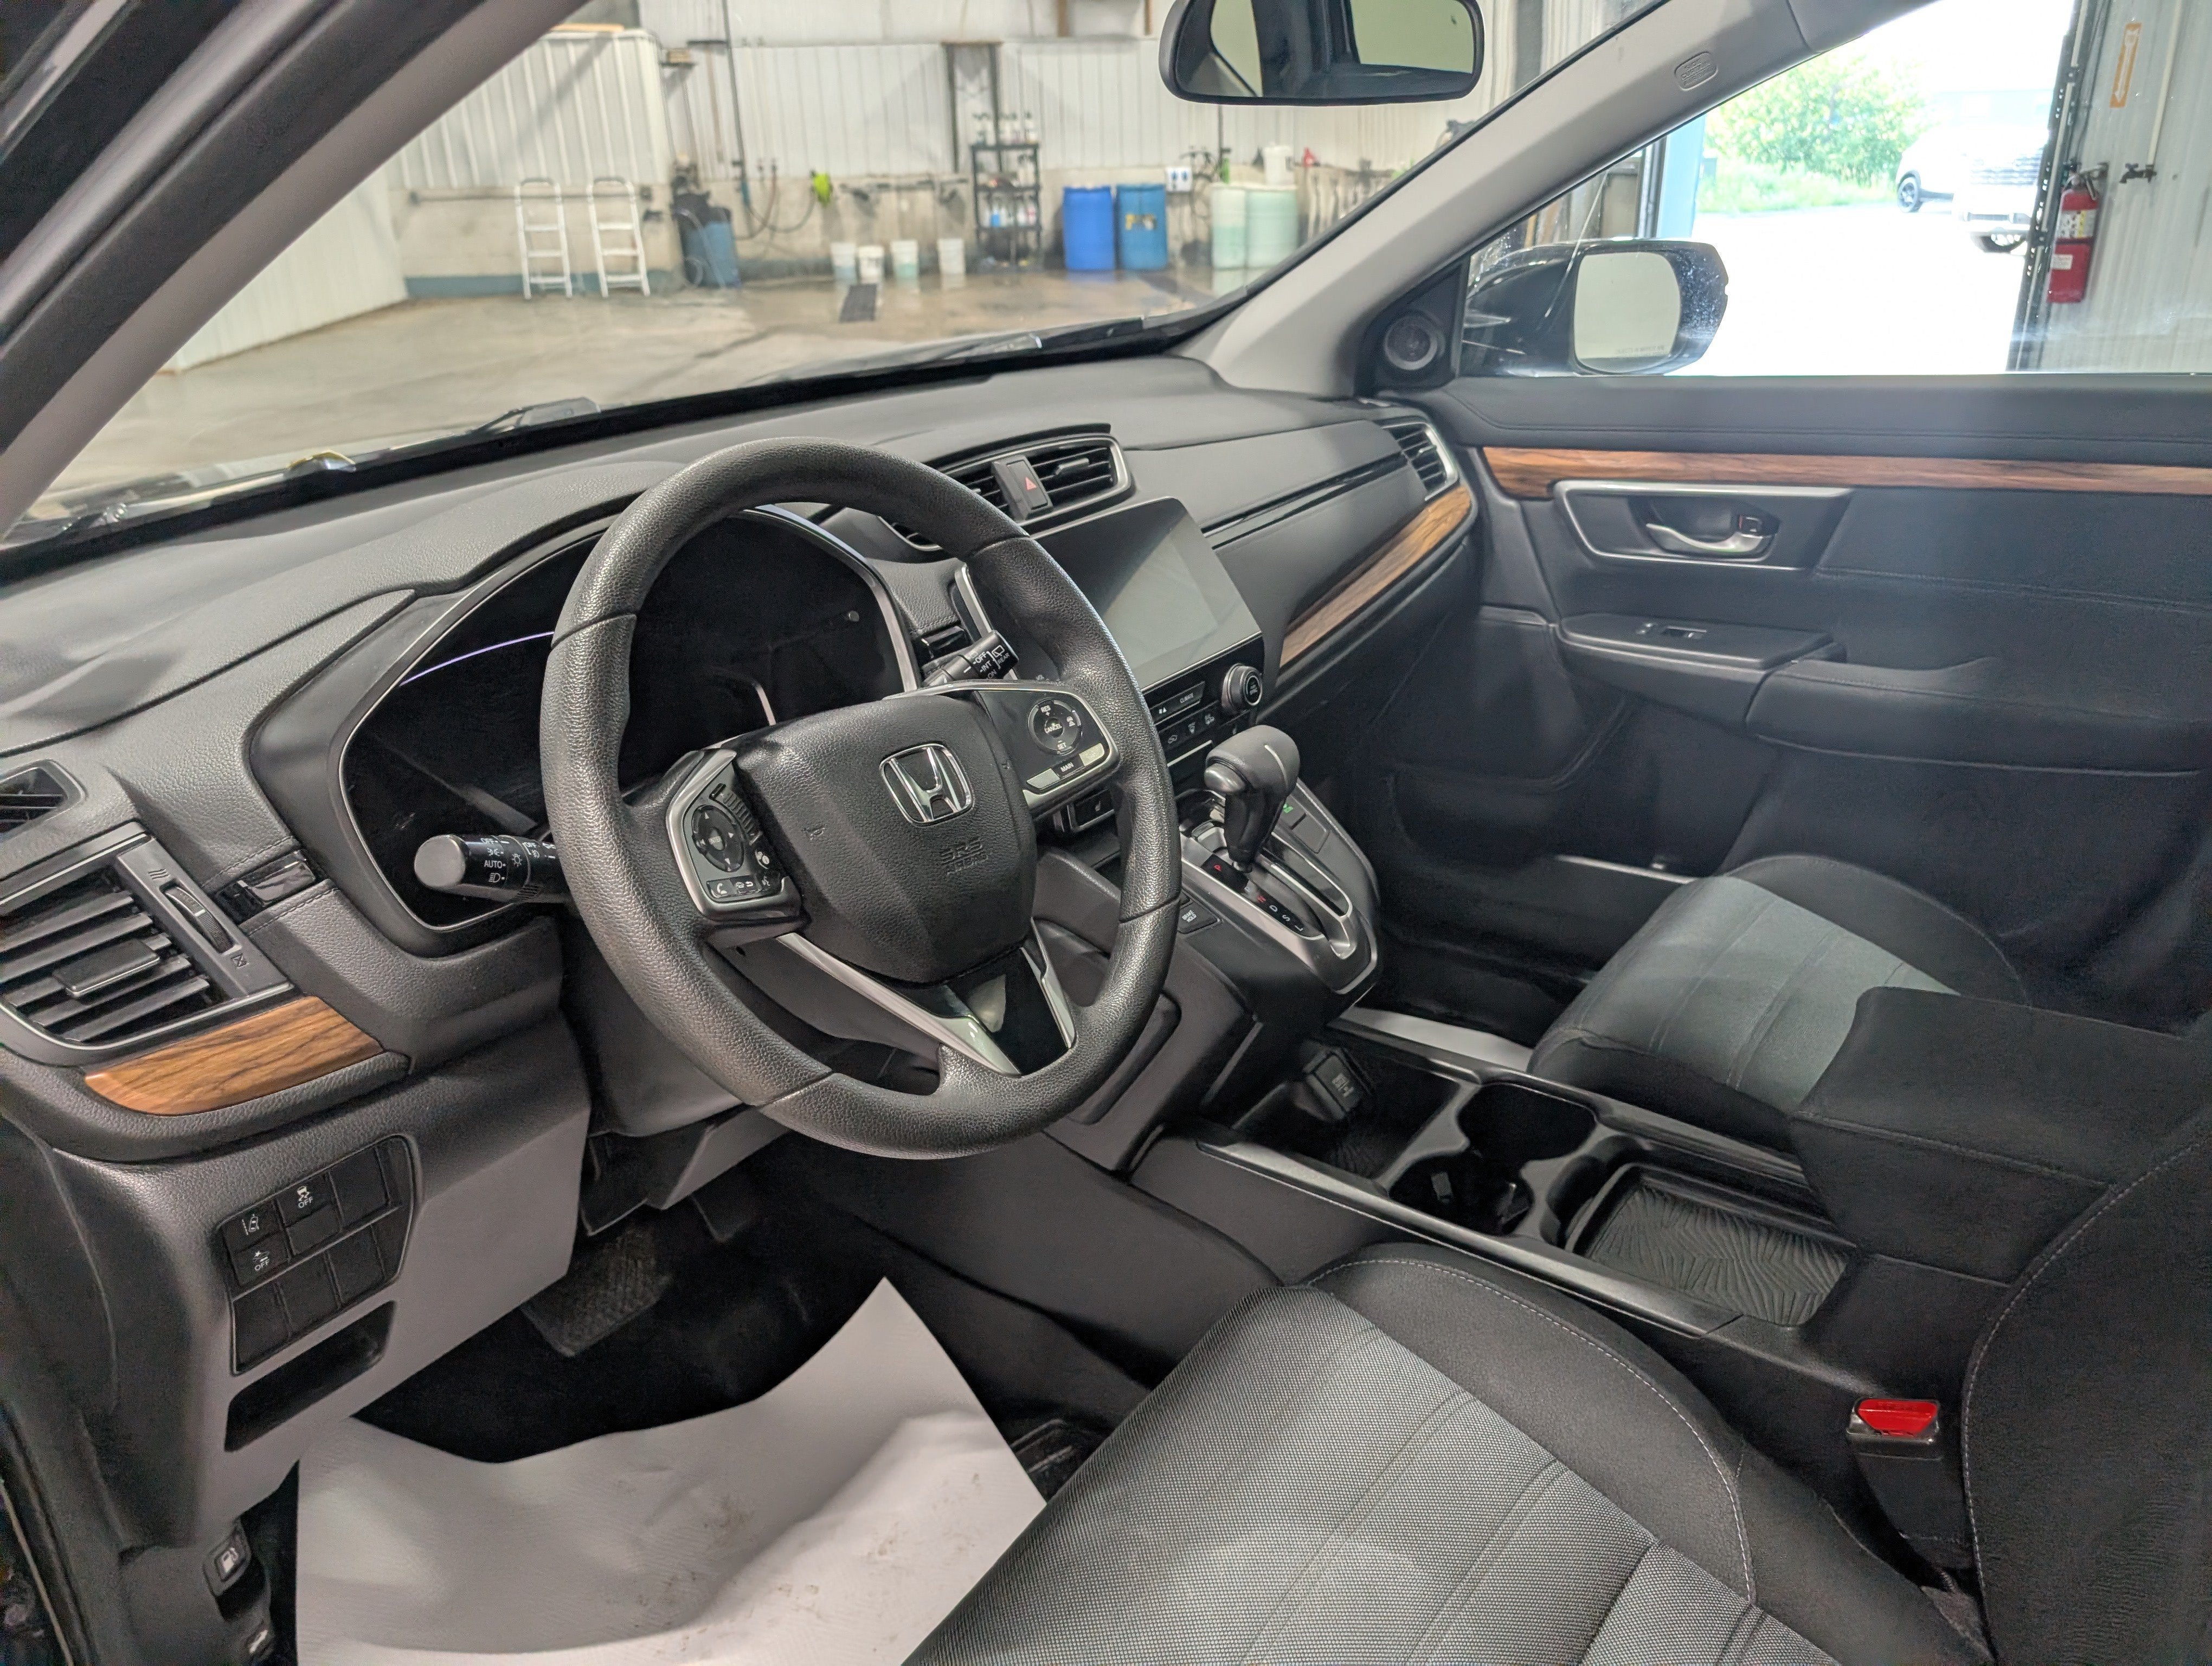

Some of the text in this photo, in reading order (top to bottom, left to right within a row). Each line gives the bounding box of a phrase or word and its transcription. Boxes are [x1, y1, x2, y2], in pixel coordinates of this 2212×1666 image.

[975, 651, 987, 663] OFF
[998, 652, 1009, 664] REAR
[981, 660, 992, 672] INT
[987, 669, 997, 678] ON
[1040, 705, 1051, 713] RES
[1060, 762, 1074, 772] MAIN
[484, 860, 503, 869] AUTO
[298, 1196, 313, 1208] OFF
[254, 1259, 270, 1271] OFF
